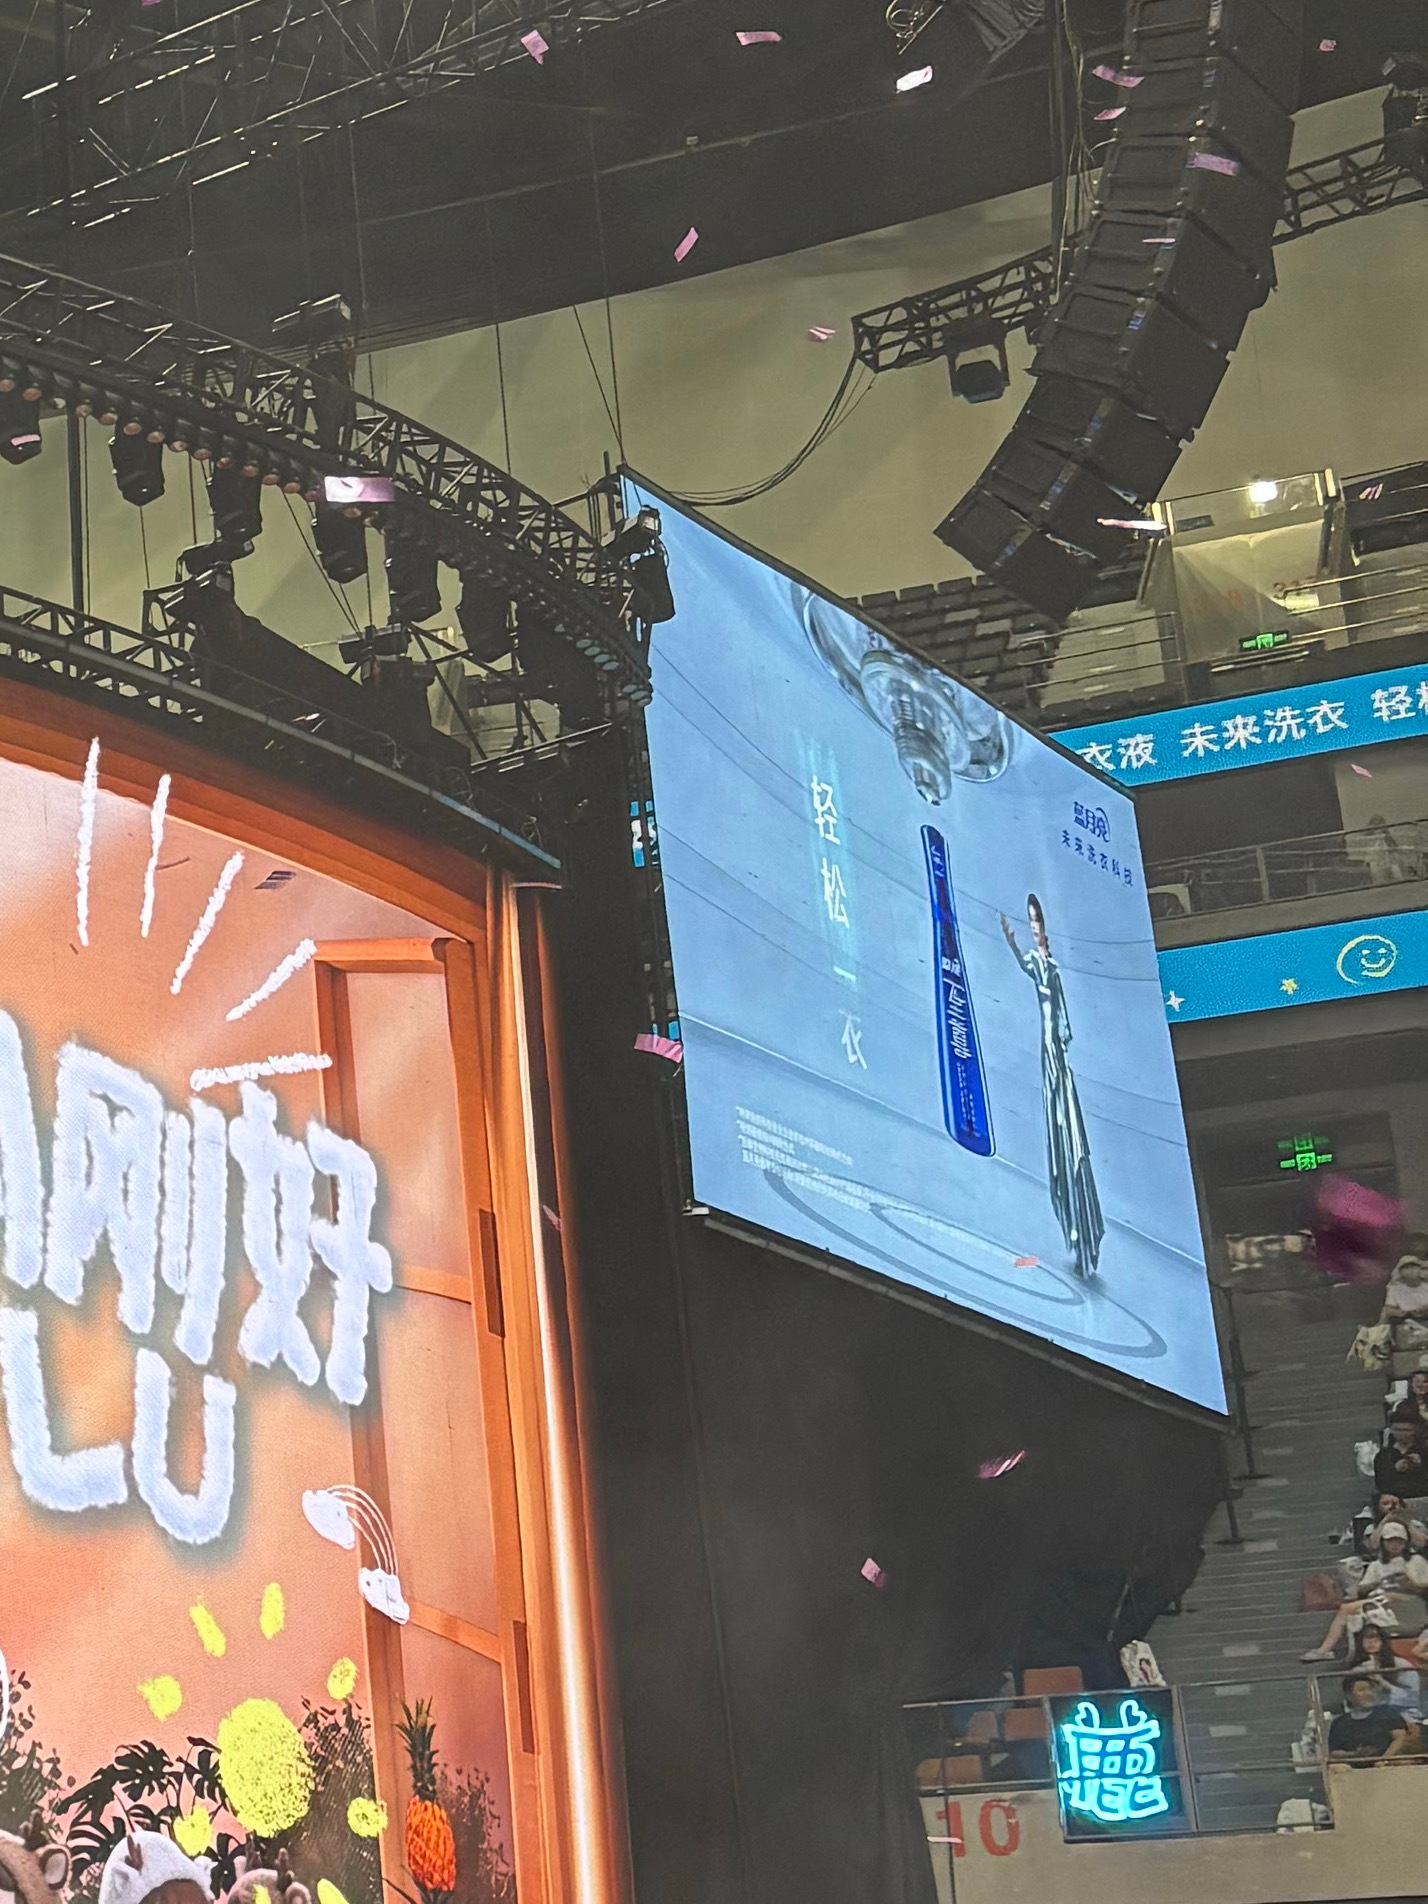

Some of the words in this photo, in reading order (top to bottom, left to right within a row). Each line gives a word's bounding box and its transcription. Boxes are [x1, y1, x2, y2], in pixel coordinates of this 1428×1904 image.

[1077, 733, 1157, 771] 衣液
[1180, 699, 1349, 758] 未来洗衣
[1371, 681, 1428, 722] 轻
[1073, 800, 1111, 843] 蓝月亮
[935, 1798, 1020, 1858] 10
